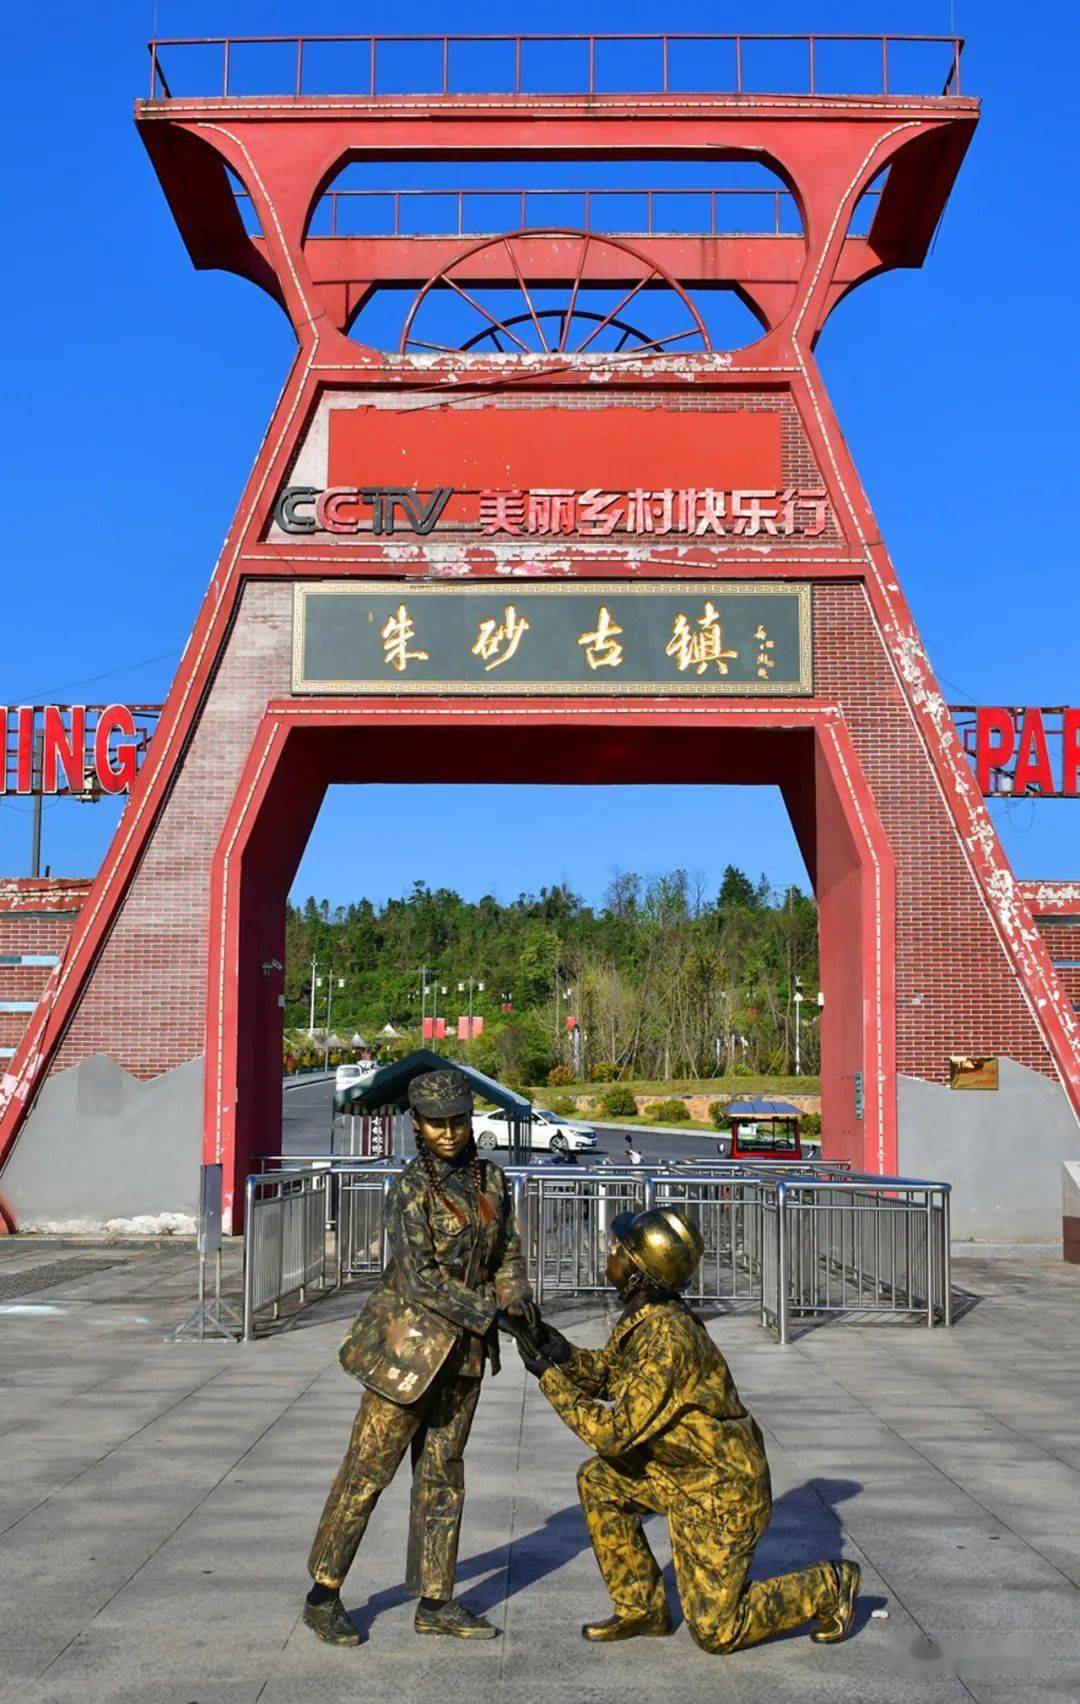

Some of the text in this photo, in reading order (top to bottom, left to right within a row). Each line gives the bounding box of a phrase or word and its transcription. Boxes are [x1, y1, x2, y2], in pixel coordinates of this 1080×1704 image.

[274, 486, 829, 536] CCTV 美丽乡村快乐行
